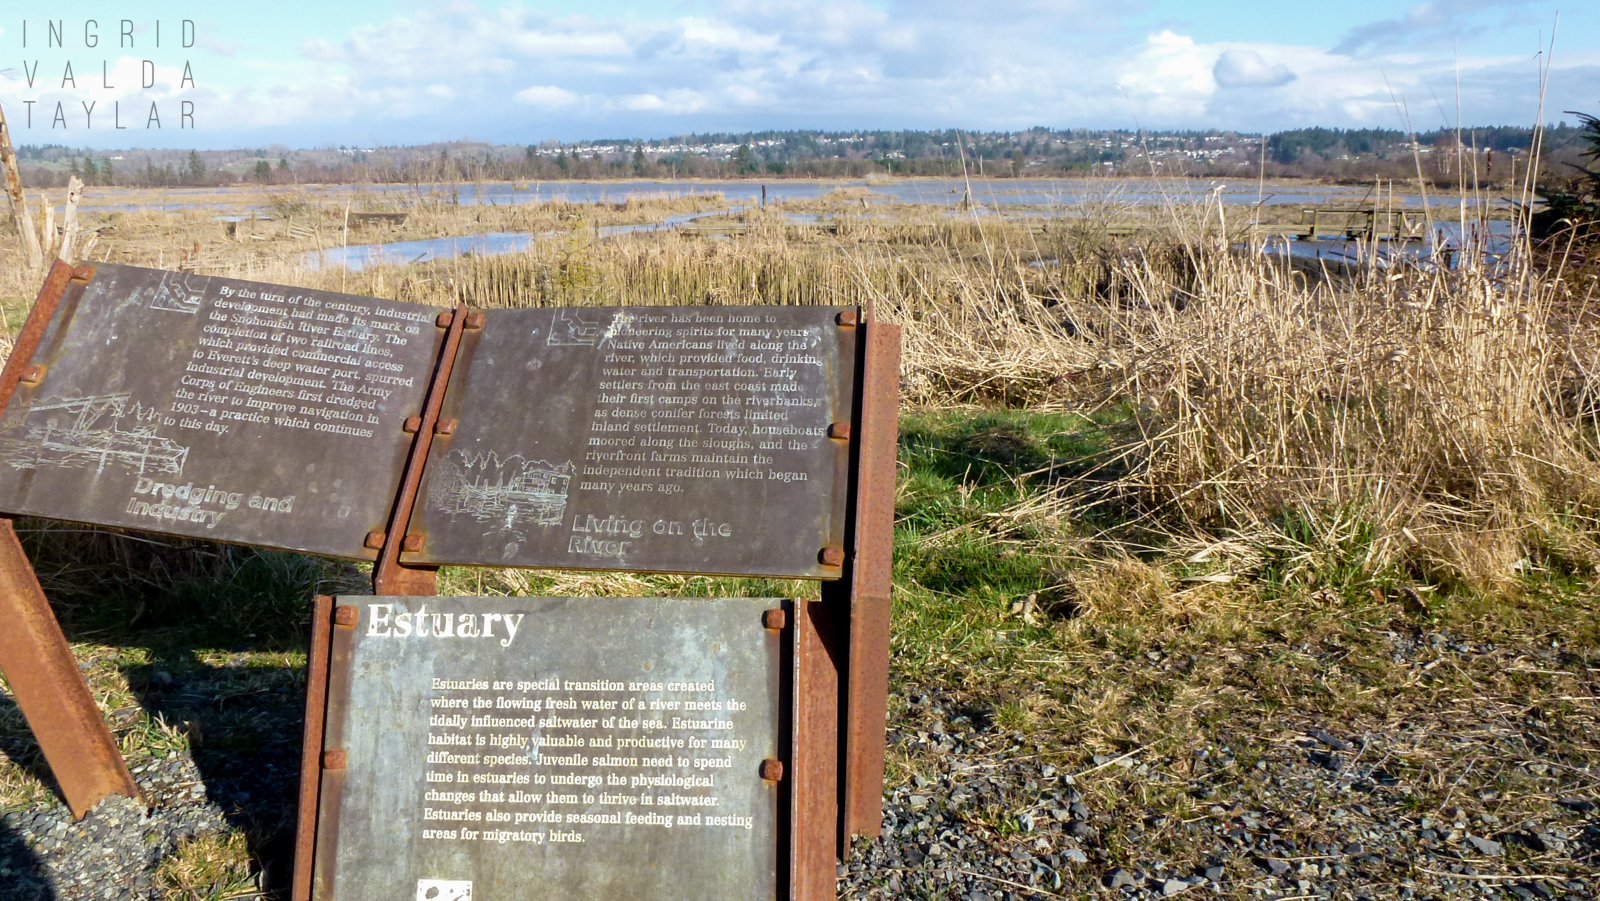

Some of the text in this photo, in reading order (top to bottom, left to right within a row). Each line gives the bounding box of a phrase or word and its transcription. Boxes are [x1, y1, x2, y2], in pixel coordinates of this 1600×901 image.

[219, 286, 433, 322] By the turn of the century, industrial
[214, 298, 421, 334] development had made its mark on
[203, 325, 393, 358] completion of two railroad lines,
[606, 340, 807, 352] Native Americans lived along the
[197, 336, 404, 371] which provided commercial access
[186, 361, 393, 400] industrial development. The Army
[601, 367, 797, 380] water and transportation. Early
[180, 374, 377, 410] Corps of Engineers first dredged
[175, 388, 381, 424] the river to improve navigation in
[610, 408, 649, 417] dense
[650, 408, 694, 418] conifer
[698, 409, 740, 418] forests
[744, 409, 788, 419] limited
[163, 415, 228, 435] to this day.
[590, 421, 824, 437] inland settlement. Today, houseboats
[587, 436, 807, 451] moored along the sloughs, and the
[584, 450, 773, 463] riverfront farms maintain the
[581, 465, 808, 483] independent tradition which began
[134, 476, 295, 513] Dredging and
[579, 482, 684, 495] many years ago.
[126, 497, 226, 528] Industry
[571, 513, 732, 539] Living on the
[567, 534, 632, 554] River
[365, 603, 524, 647] Estuary
[431, 677, 715, 694] Estuaries are special transition areas created
[430, 696, 746, 713] where the flowing fresh water of a river meets the
[428, 714, 733, 731] tidally influenced saltwater of the sea. Estuarine
[427, 733, 746, 752] habitat is highly valuable and productive for many
[426, 752, 732, 771] different species. Juvenile salmon need to spend
[425, 771, 714, 790] time in estuaries to undergo the physiological
[424, 789, 719, 806] changes that allow them to thrive in saltwater.
[423, 809, 753, 828] Estuaries also provide seasonal feeding and nesting
[422, 827, 585, 845] areas for migratory birds.
